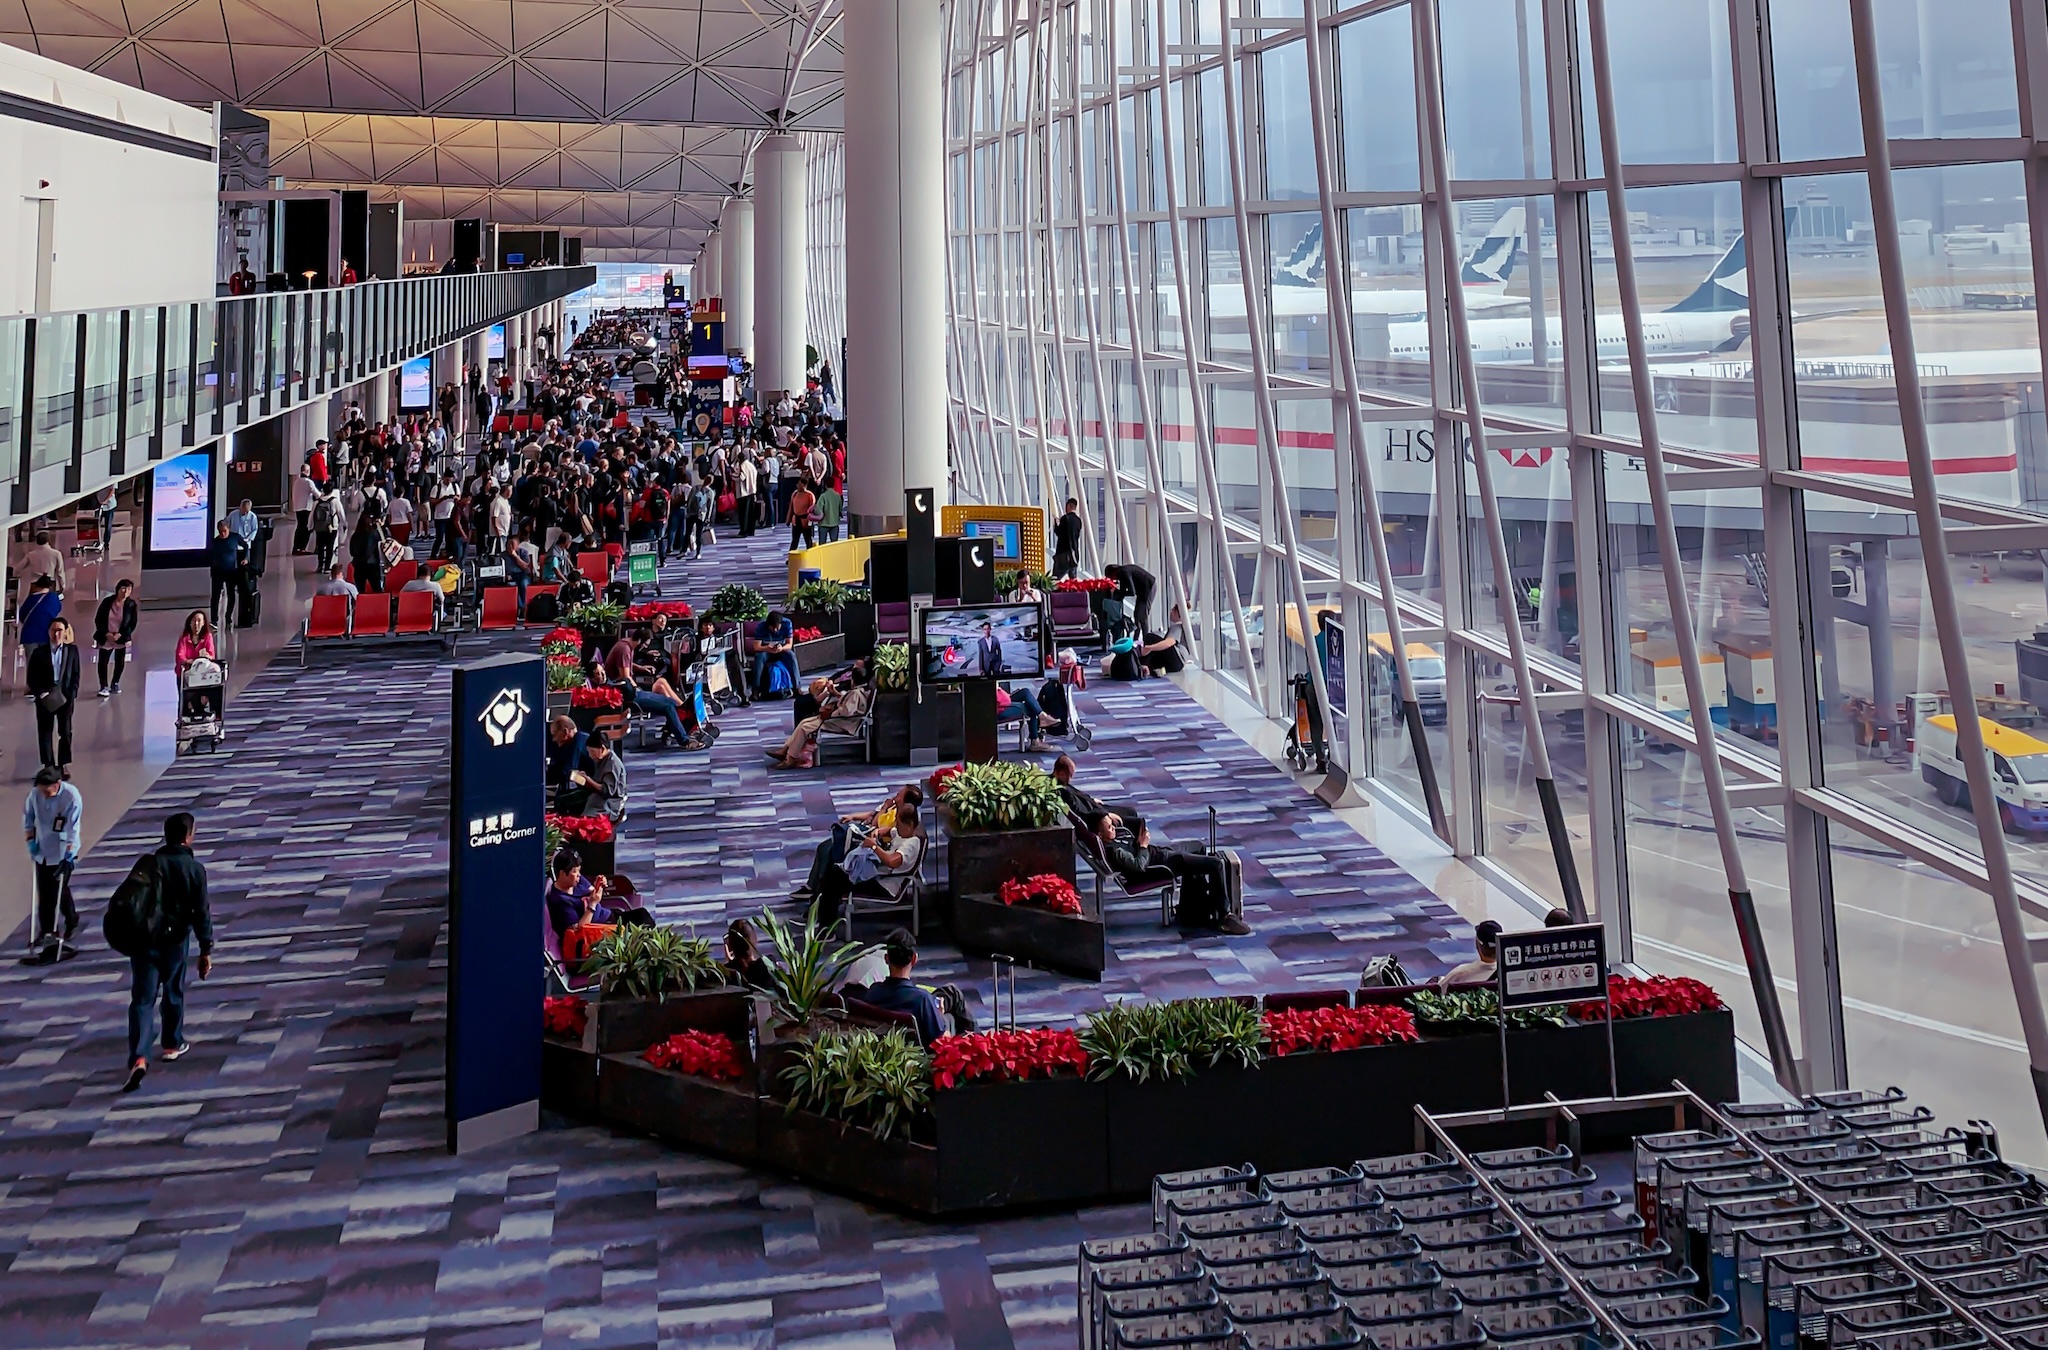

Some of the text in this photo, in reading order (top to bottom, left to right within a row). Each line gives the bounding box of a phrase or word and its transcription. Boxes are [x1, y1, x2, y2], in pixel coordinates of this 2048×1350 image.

[674, 288, 681, 297] 2
[703, 324, 712, 340] 1
[470, 827, 537, 848] Caring Corner
